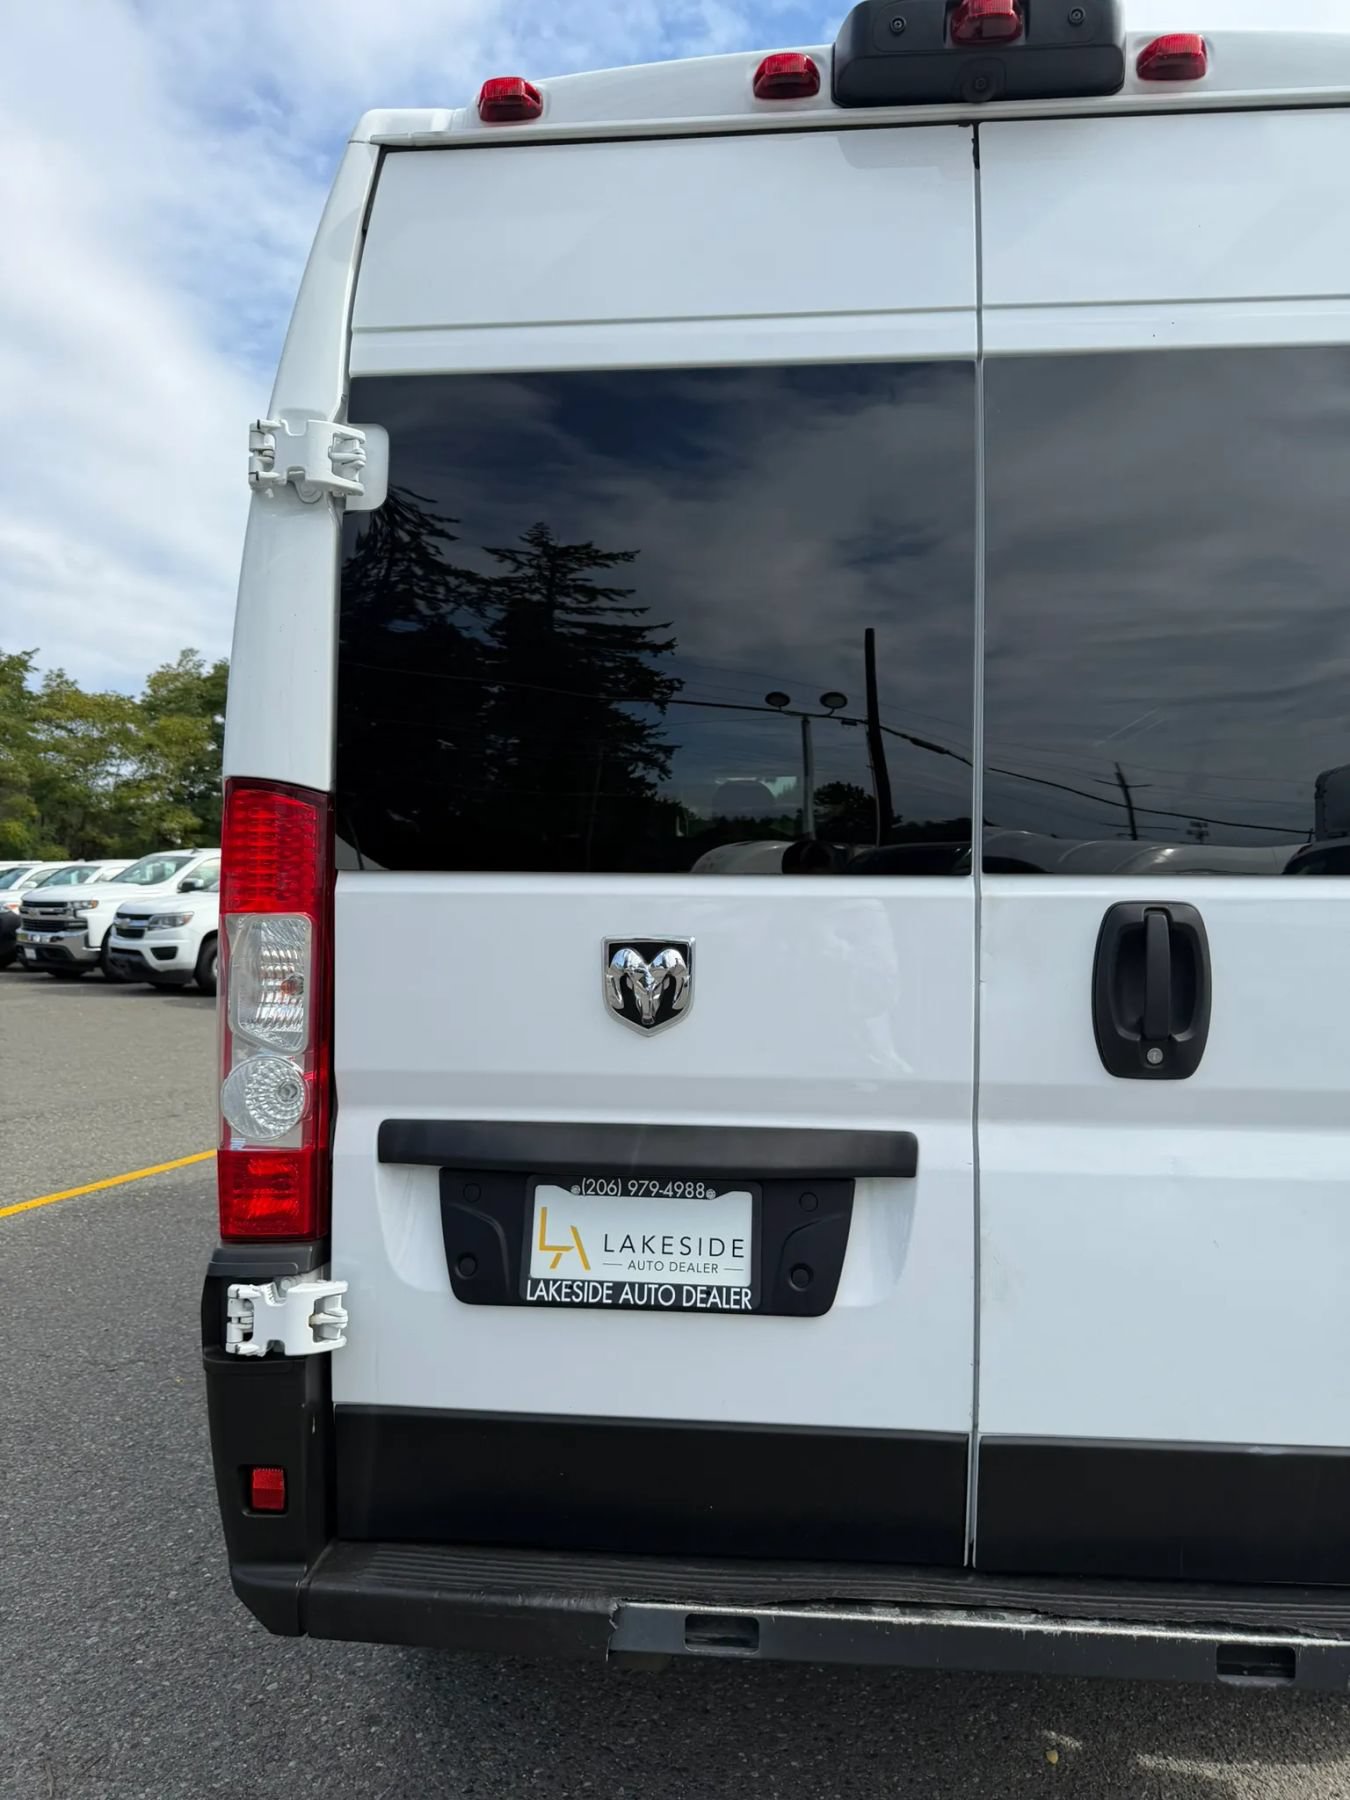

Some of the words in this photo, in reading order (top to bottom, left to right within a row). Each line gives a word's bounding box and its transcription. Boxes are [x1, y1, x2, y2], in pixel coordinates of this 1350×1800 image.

[581, 1177, 622, 1197] (206)
[628, 1180, 706, 1199] 979-4988
[603, 1233, 745, 1258] LAKESIDE
[628, 1260, 664, 1272] AUTO
[669, 1262, 719, 1274] DEALER
[526, 1280, 613, 1304] LAKESIDE
[619, 1283, 676, 1306] AUTO
[682, 1286, 752, 1310] DEALER
